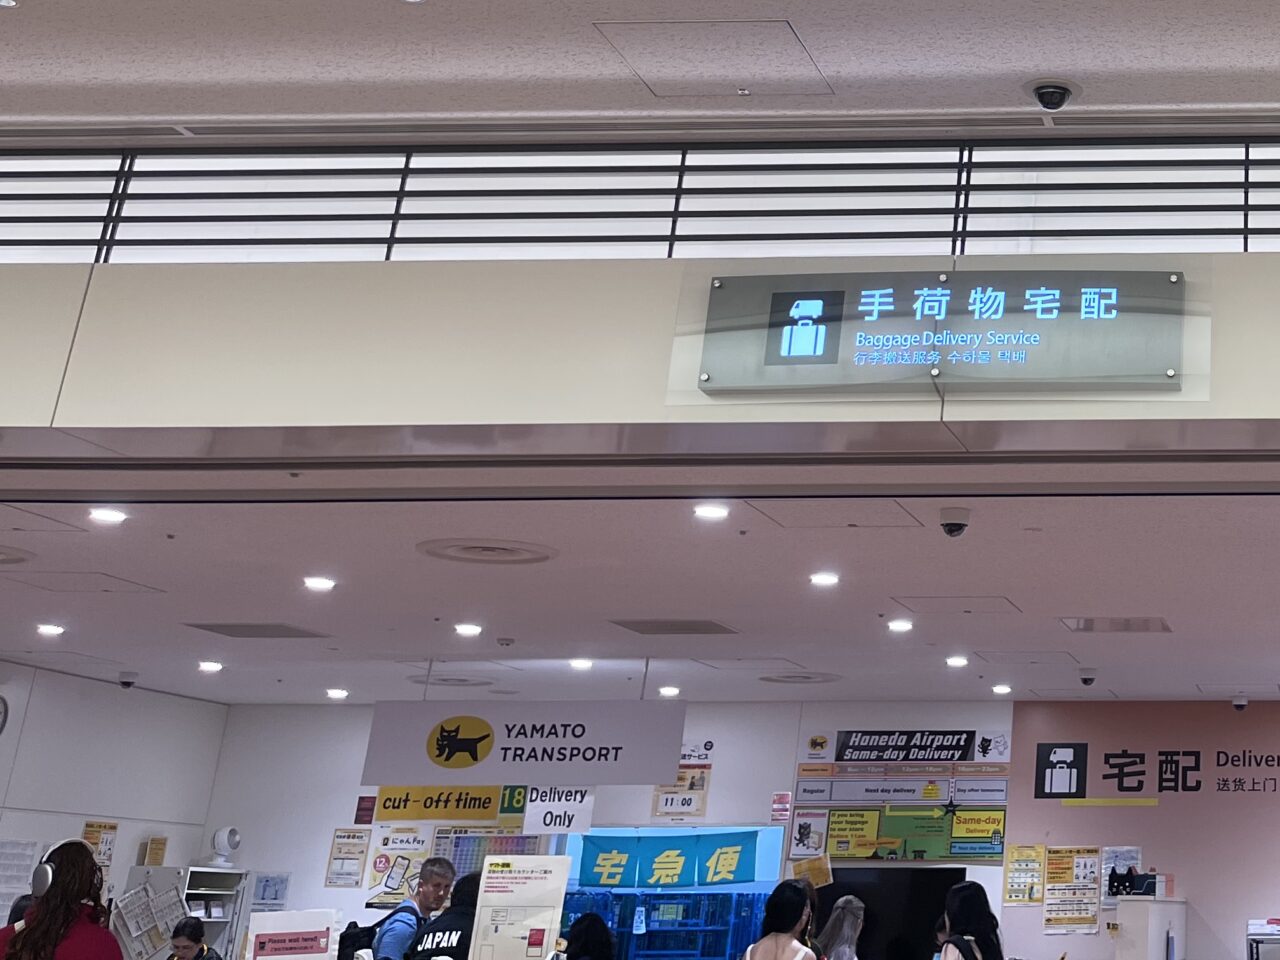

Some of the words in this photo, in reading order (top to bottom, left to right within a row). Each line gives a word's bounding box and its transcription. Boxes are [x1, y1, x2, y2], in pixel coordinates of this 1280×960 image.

[857, 286, 1118, 321] 手荷物宅配
[855, 332, 920, 349] Baggage
[922, 330, 982, 349] Delivery
[988, 330, 1040, 346] Service
[853, 350, 942, 365] 行李搬送服务
[947, 350, 991, 364] 수하물
[998, 349, 1027, 364] 택배
[504, 723, 586, 739] YAMATO
[849, 732, 907, 746] Haneda
[909, 732, 967, 746] Airport
[500, 747, 623, 762] TRANSPORT
[843, 748, 905, 760] Same-day
[909, 747, 962, 761] Delivery
[1102, 749, 1201, 793] 宅配
[1216, 777, 1277, 792] 送货上门
[455, 792, 492, 809] time
[503, 787, 525, 808] 18
[529, 787, 588, 803] Delivery
[543, 811, 575, 828] Only
[955, 815, 1002, 826] Same-day
[593, 845, 742, 885] 宅急便
[417, 930, 461, 951] JAPAN
